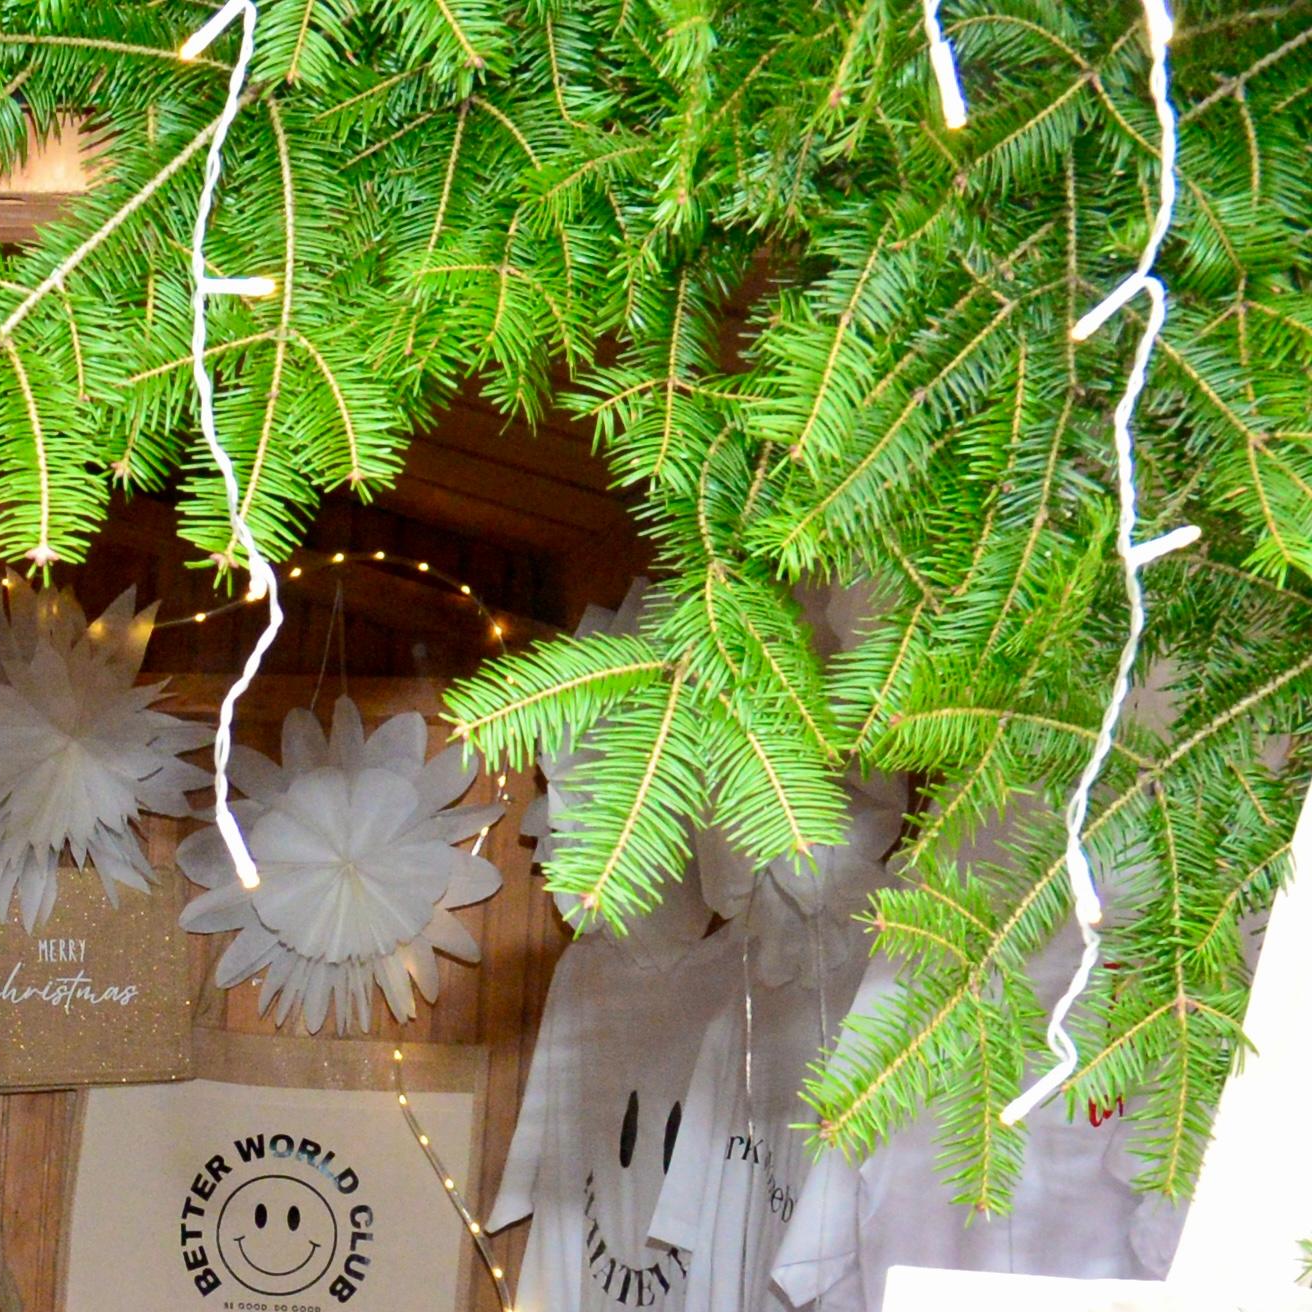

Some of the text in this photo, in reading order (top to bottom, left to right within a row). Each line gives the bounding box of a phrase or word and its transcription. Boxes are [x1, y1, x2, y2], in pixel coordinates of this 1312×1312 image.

[36, 938, 86, 963] MERRY
[180, 1133, 374, 1304] BETTER WORLD CLUB
